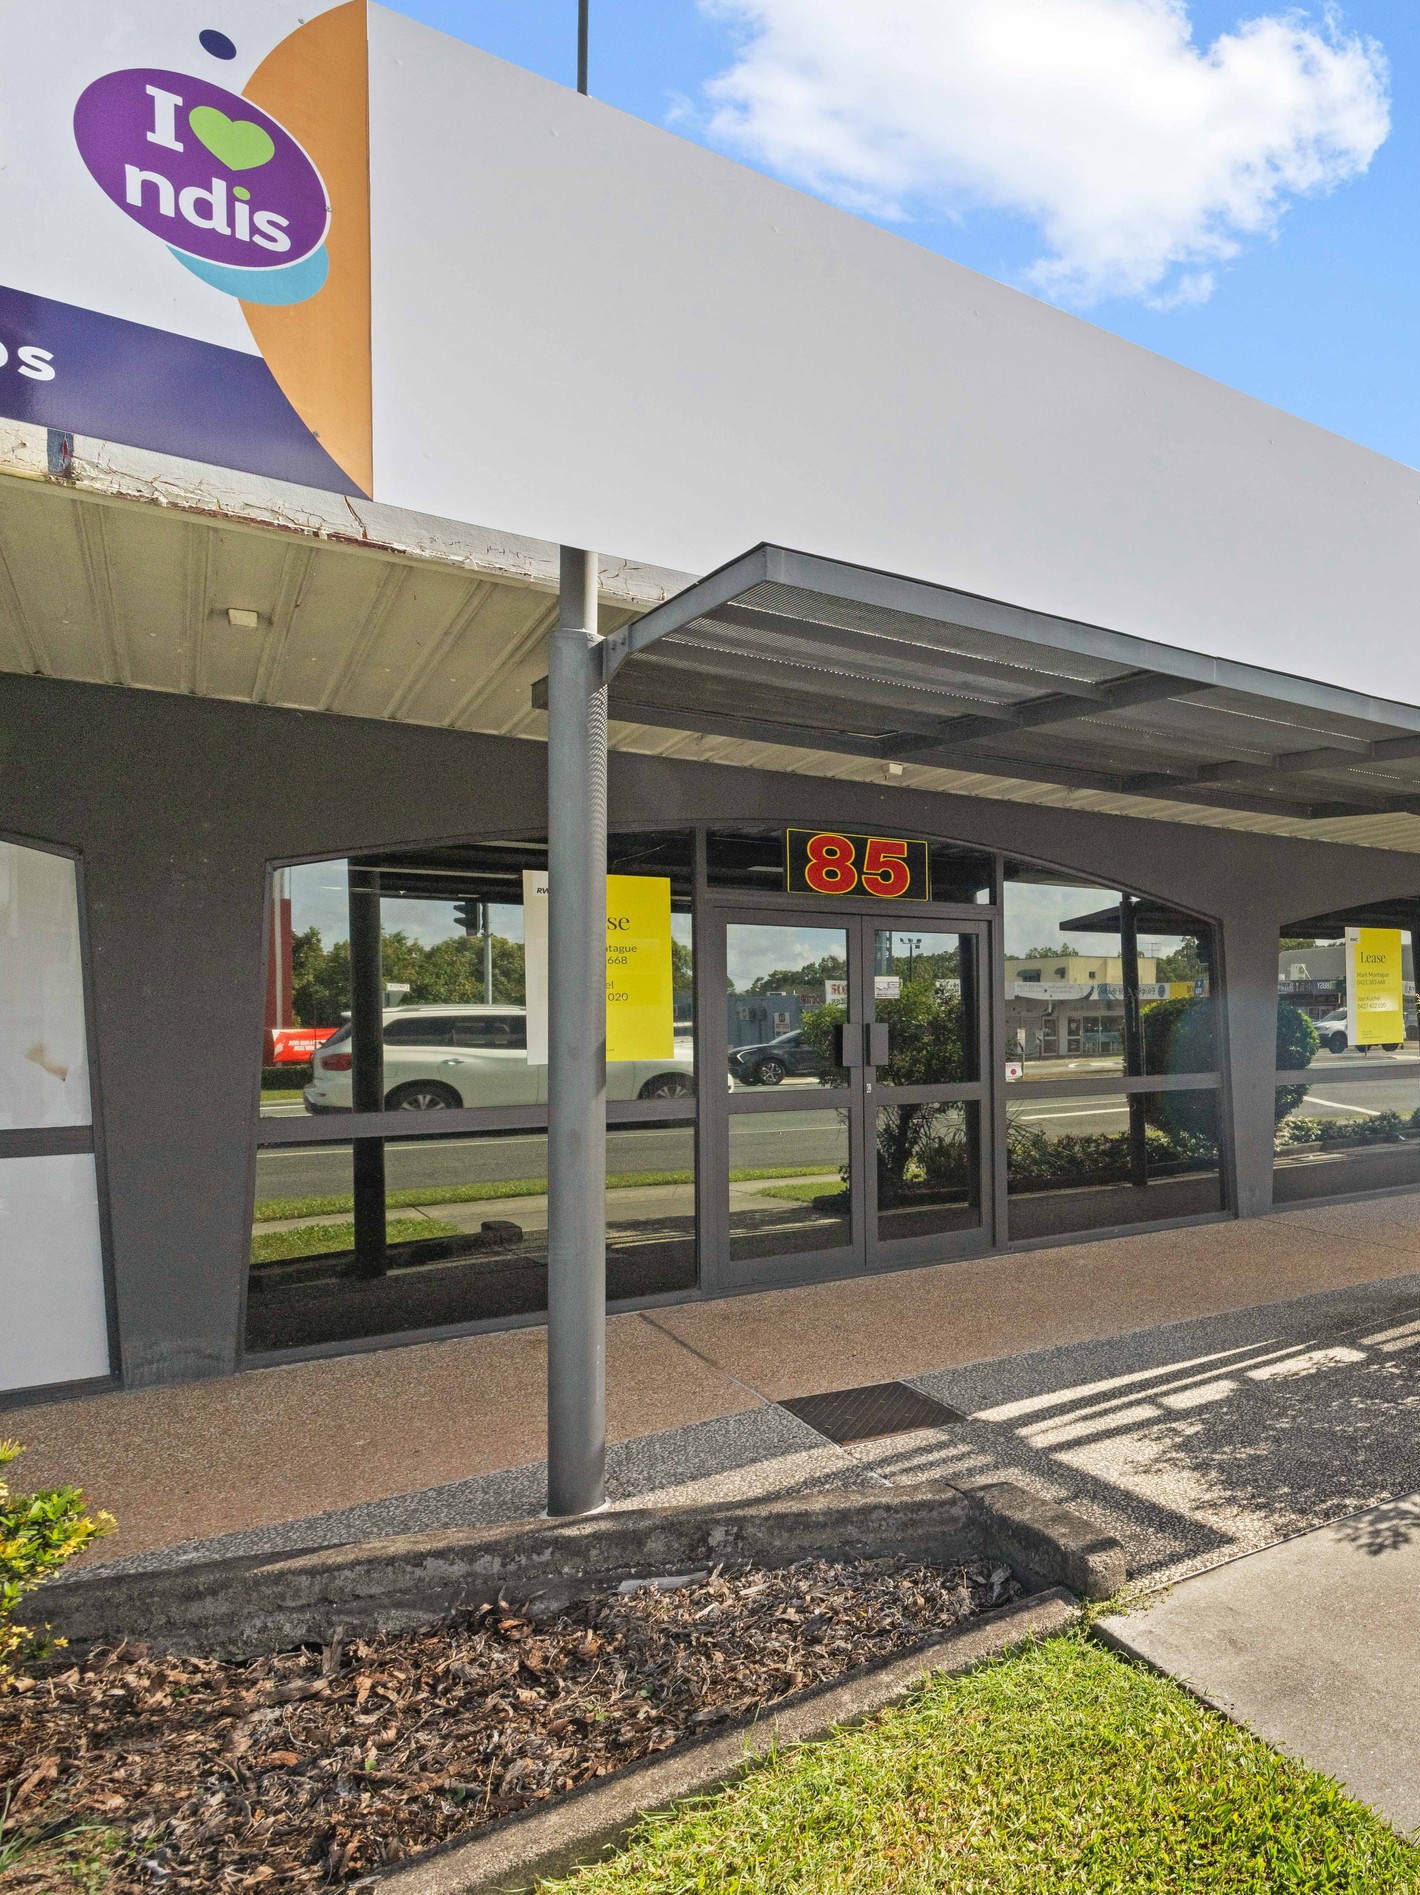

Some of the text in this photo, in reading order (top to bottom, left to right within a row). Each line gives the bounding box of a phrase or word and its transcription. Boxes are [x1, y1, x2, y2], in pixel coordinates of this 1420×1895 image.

[146, 84, 184, 153] I
[124, 163, 292, 253] ndis
[804, 833, 911, 898] 85
[607, 956, 628, 965] 668
[1360, 951, 1386, 964] Lease
[608, 992, 629, 1002] 020
